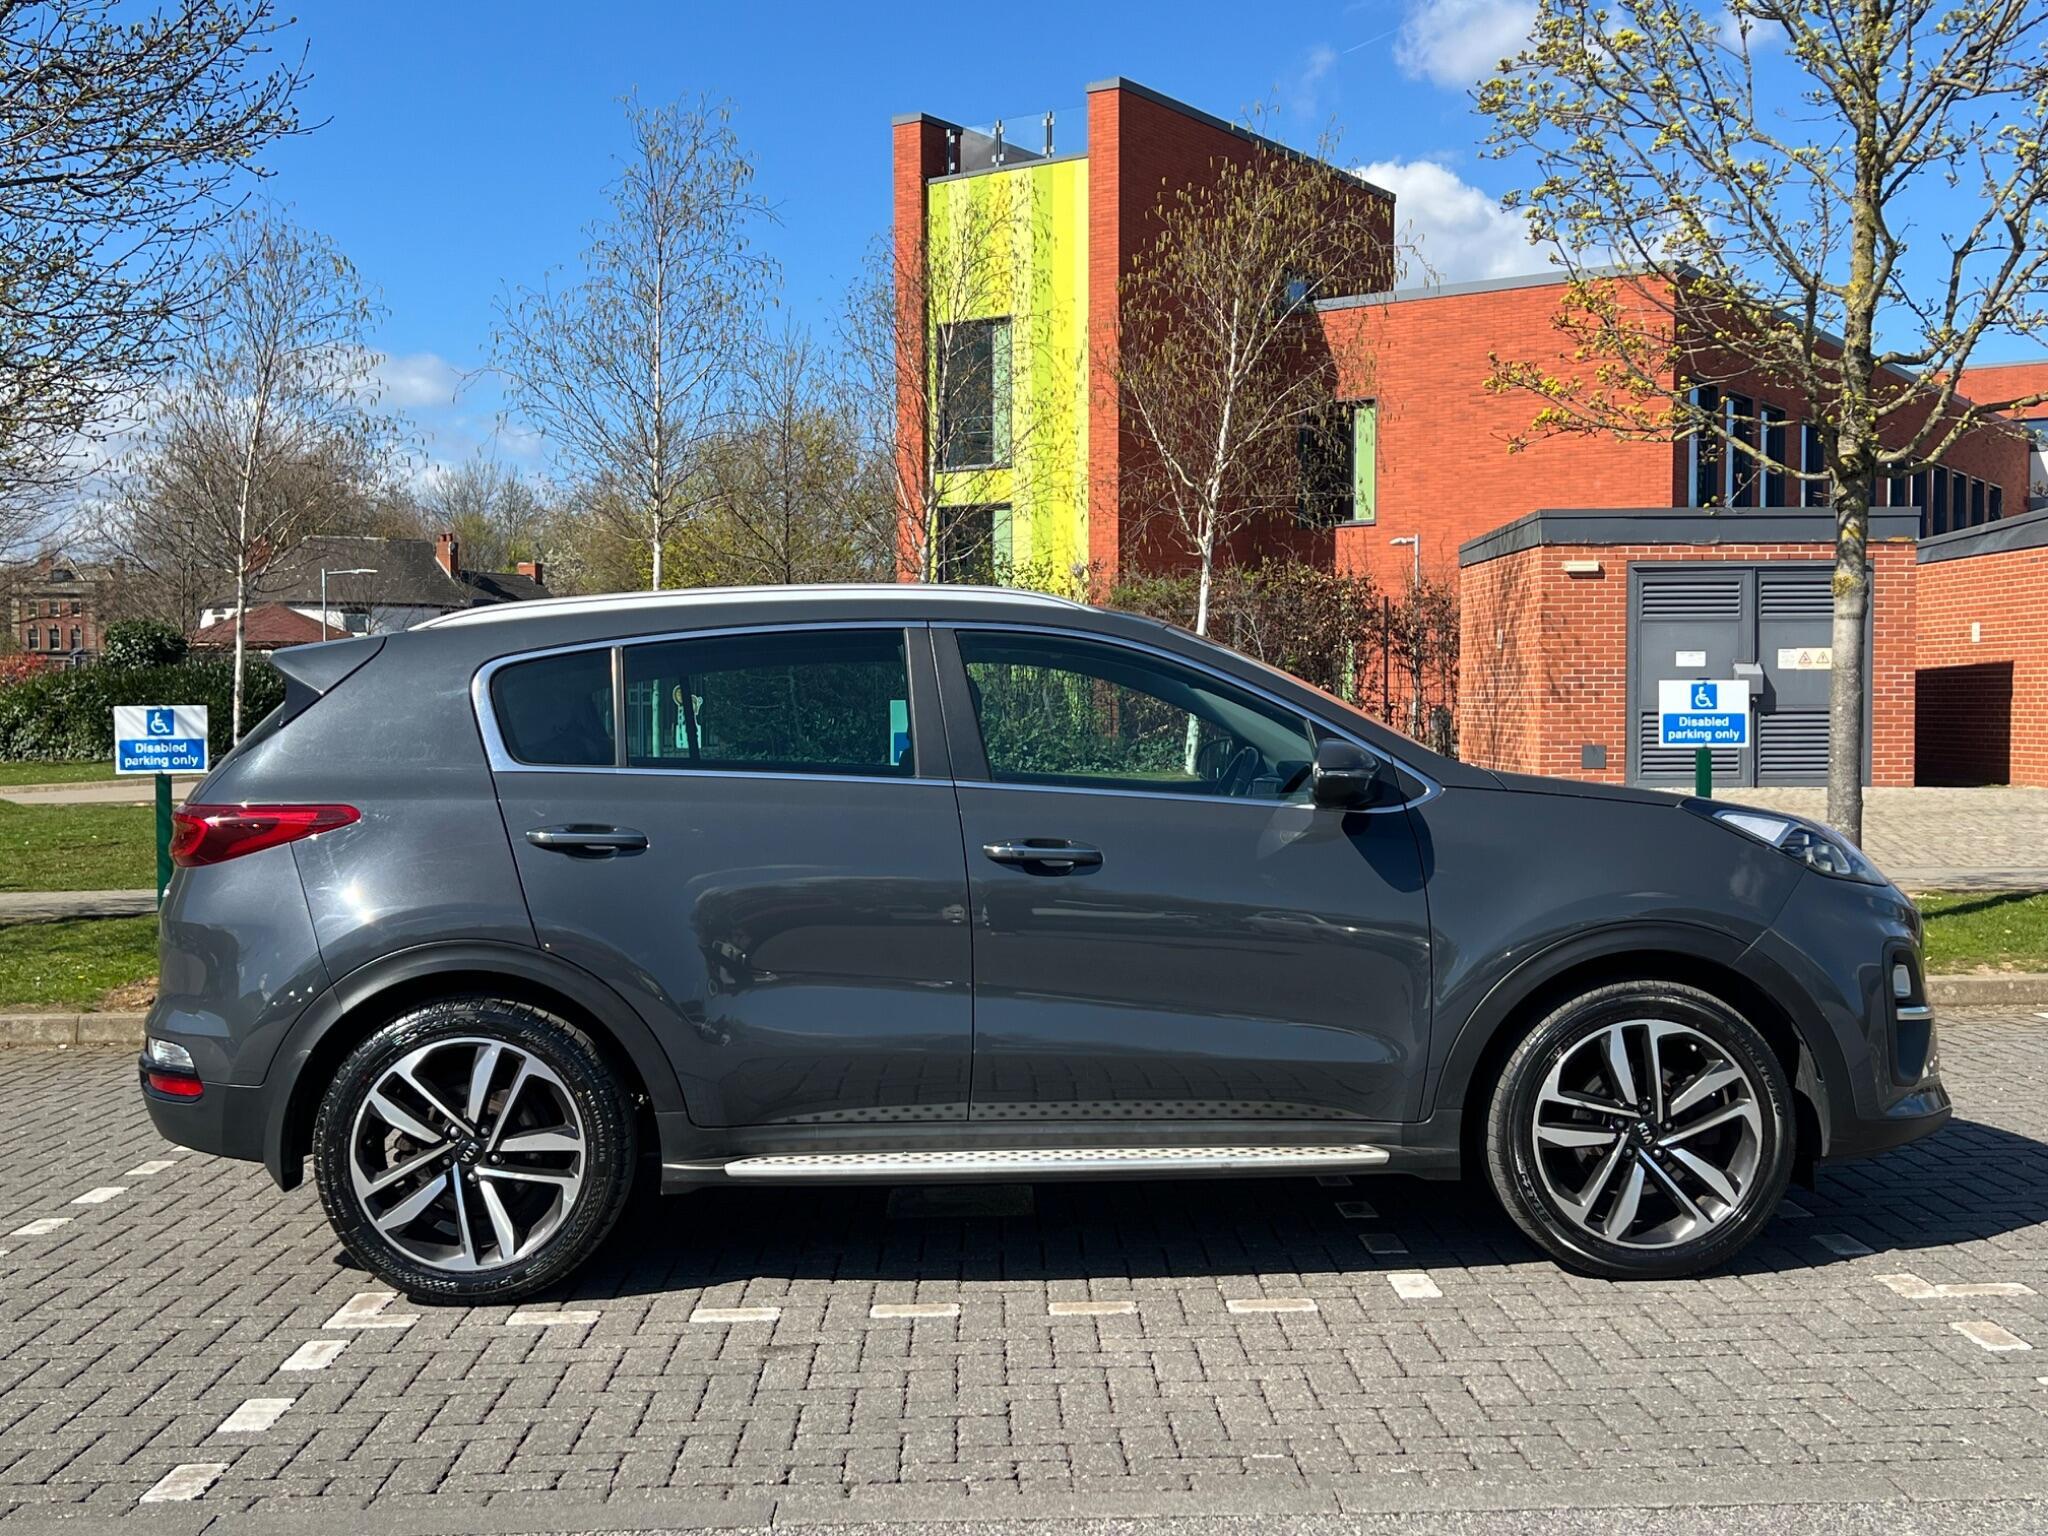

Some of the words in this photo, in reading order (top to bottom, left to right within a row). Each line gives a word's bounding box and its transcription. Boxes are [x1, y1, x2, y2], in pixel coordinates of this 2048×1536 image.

[1679, 716, 1730, 727] Disabled
[1668, 729, 1712, 742] parking
[1714, 729, 1740, 742] only
[135, 742, 187, 753] Disabled
[125, 755, 169, 767] parking
[172, 755, 198, 767] only
[1637, 1122, 1653, 1144] KIA
[460, 1142, 480, 1162] KIA
